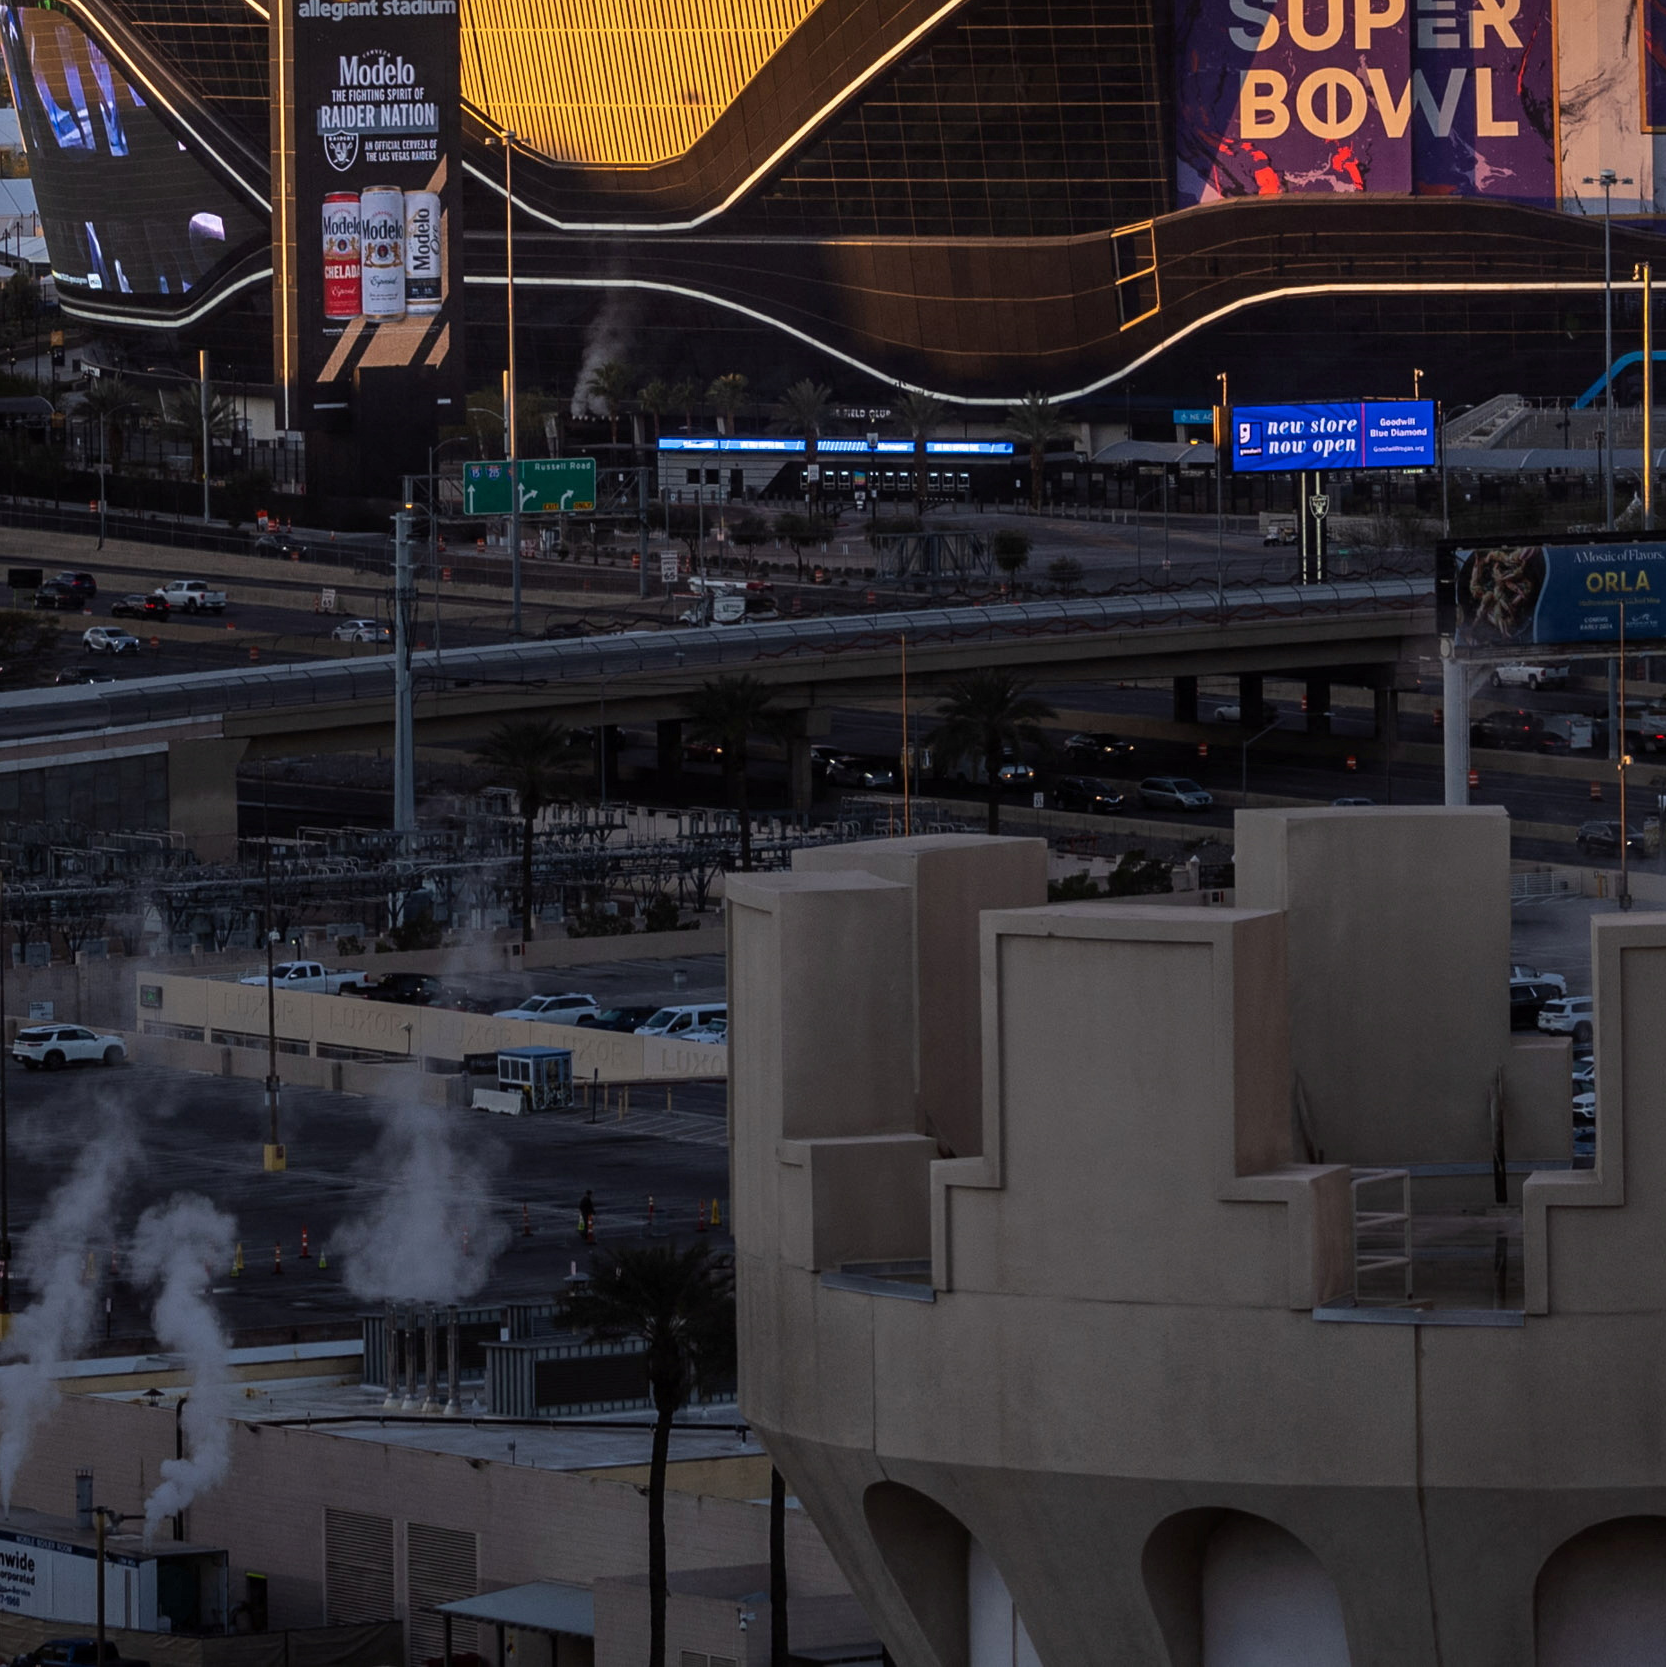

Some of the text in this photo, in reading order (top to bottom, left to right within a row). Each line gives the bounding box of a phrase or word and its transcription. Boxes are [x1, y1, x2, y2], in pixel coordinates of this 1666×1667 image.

[339, 56, 415, 86] Modelo
[332, 87, 424, 102] THE FIGHTING SPIRIT OF
[1239, 65, 1518, 139] BOWL
[321, 103, 434, 128] RAIDER NATION
[365, 139, 437, 150] AN OFFICIAL CERVEZA OF
[366, 150, 437, 162] THE LAS VEGAS RAIDERS
[413, 208, 430, 271] Modelo
[324, 265, 360, 279] CHELADA
[1267, 417, 1358, 435] new store
[1380, 417, 1416, 427] Goodwill
[1370, 427, 1427, 437] Blue Diamond
[1269, 438, 1356, 458] now open
[488, 468, 500, 478] 215
[535, 461, 591, 471] Russell Road
[472, 469, 481, 478] 15
[1574, 549, 1665, 563] A Mosaic of Flavors.
[664, 572, 675, 580] 65
[1586, 570, 1651, 593] ORLA
[331, 1005, 407, 1037] LUXOR
